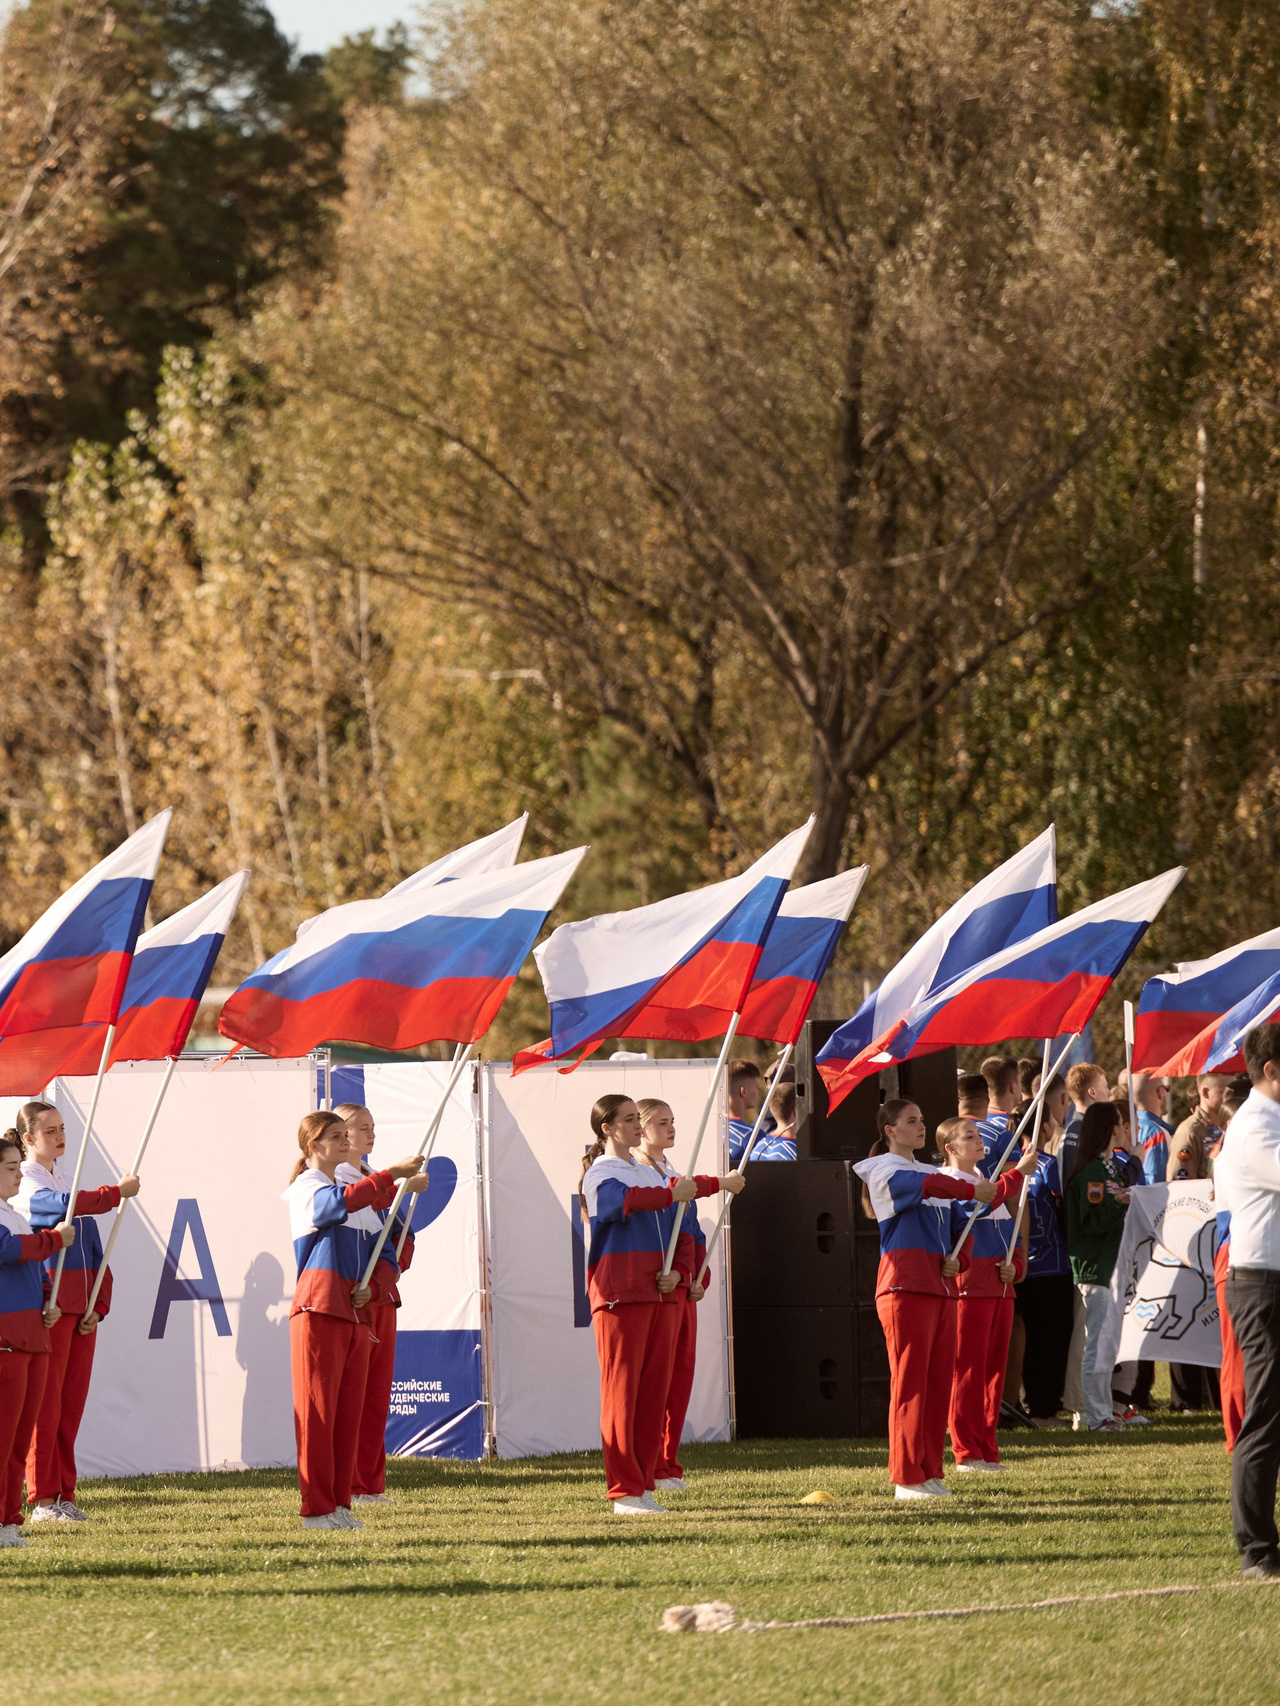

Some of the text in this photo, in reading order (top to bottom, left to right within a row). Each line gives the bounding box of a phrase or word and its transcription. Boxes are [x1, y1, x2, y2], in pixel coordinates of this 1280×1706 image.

[148, 1198, 233, 1340] А
[1201, 1309, 1220, 1327] СТИ
[391, 1379, 442, 1391] ССИЙСКИЕ
[390, 1393, 450, 1404] УДЕНЧЕСКИЕ
[389, 1405, 417, 1416] РЯДЫ
